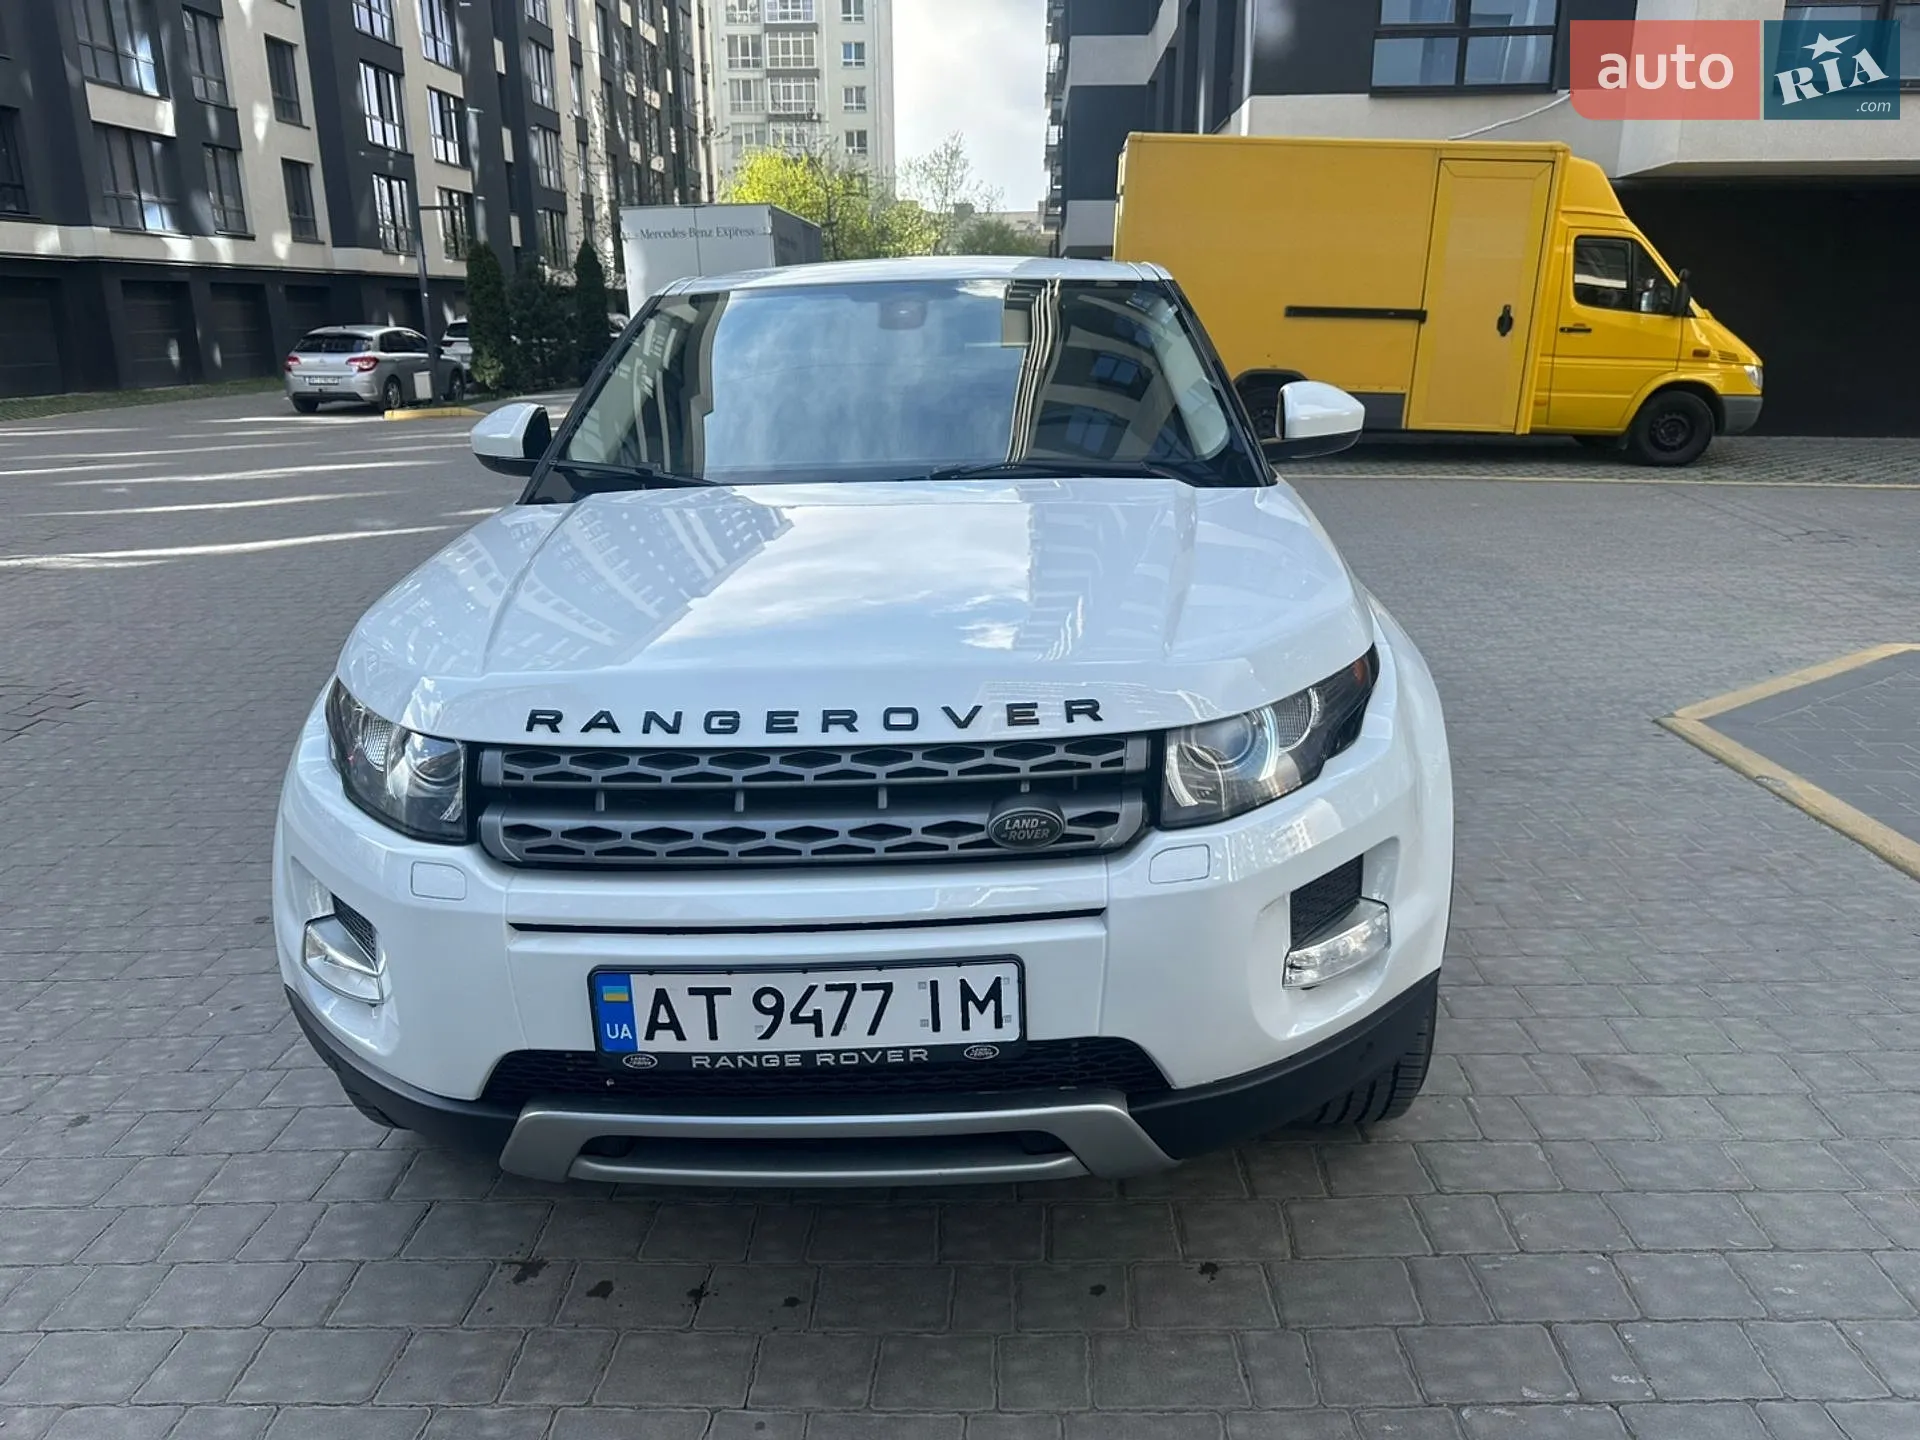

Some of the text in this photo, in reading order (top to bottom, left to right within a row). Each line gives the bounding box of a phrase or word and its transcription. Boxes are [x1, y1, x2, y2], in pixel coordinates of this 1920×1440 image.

[716, 225, 756, 240] Express
[644, 976, 1003, 1041] AT 9477 IM
[606, 1023, 633, 1040] UA
[691, 1048, 929, 1069] RANGE ROVER
